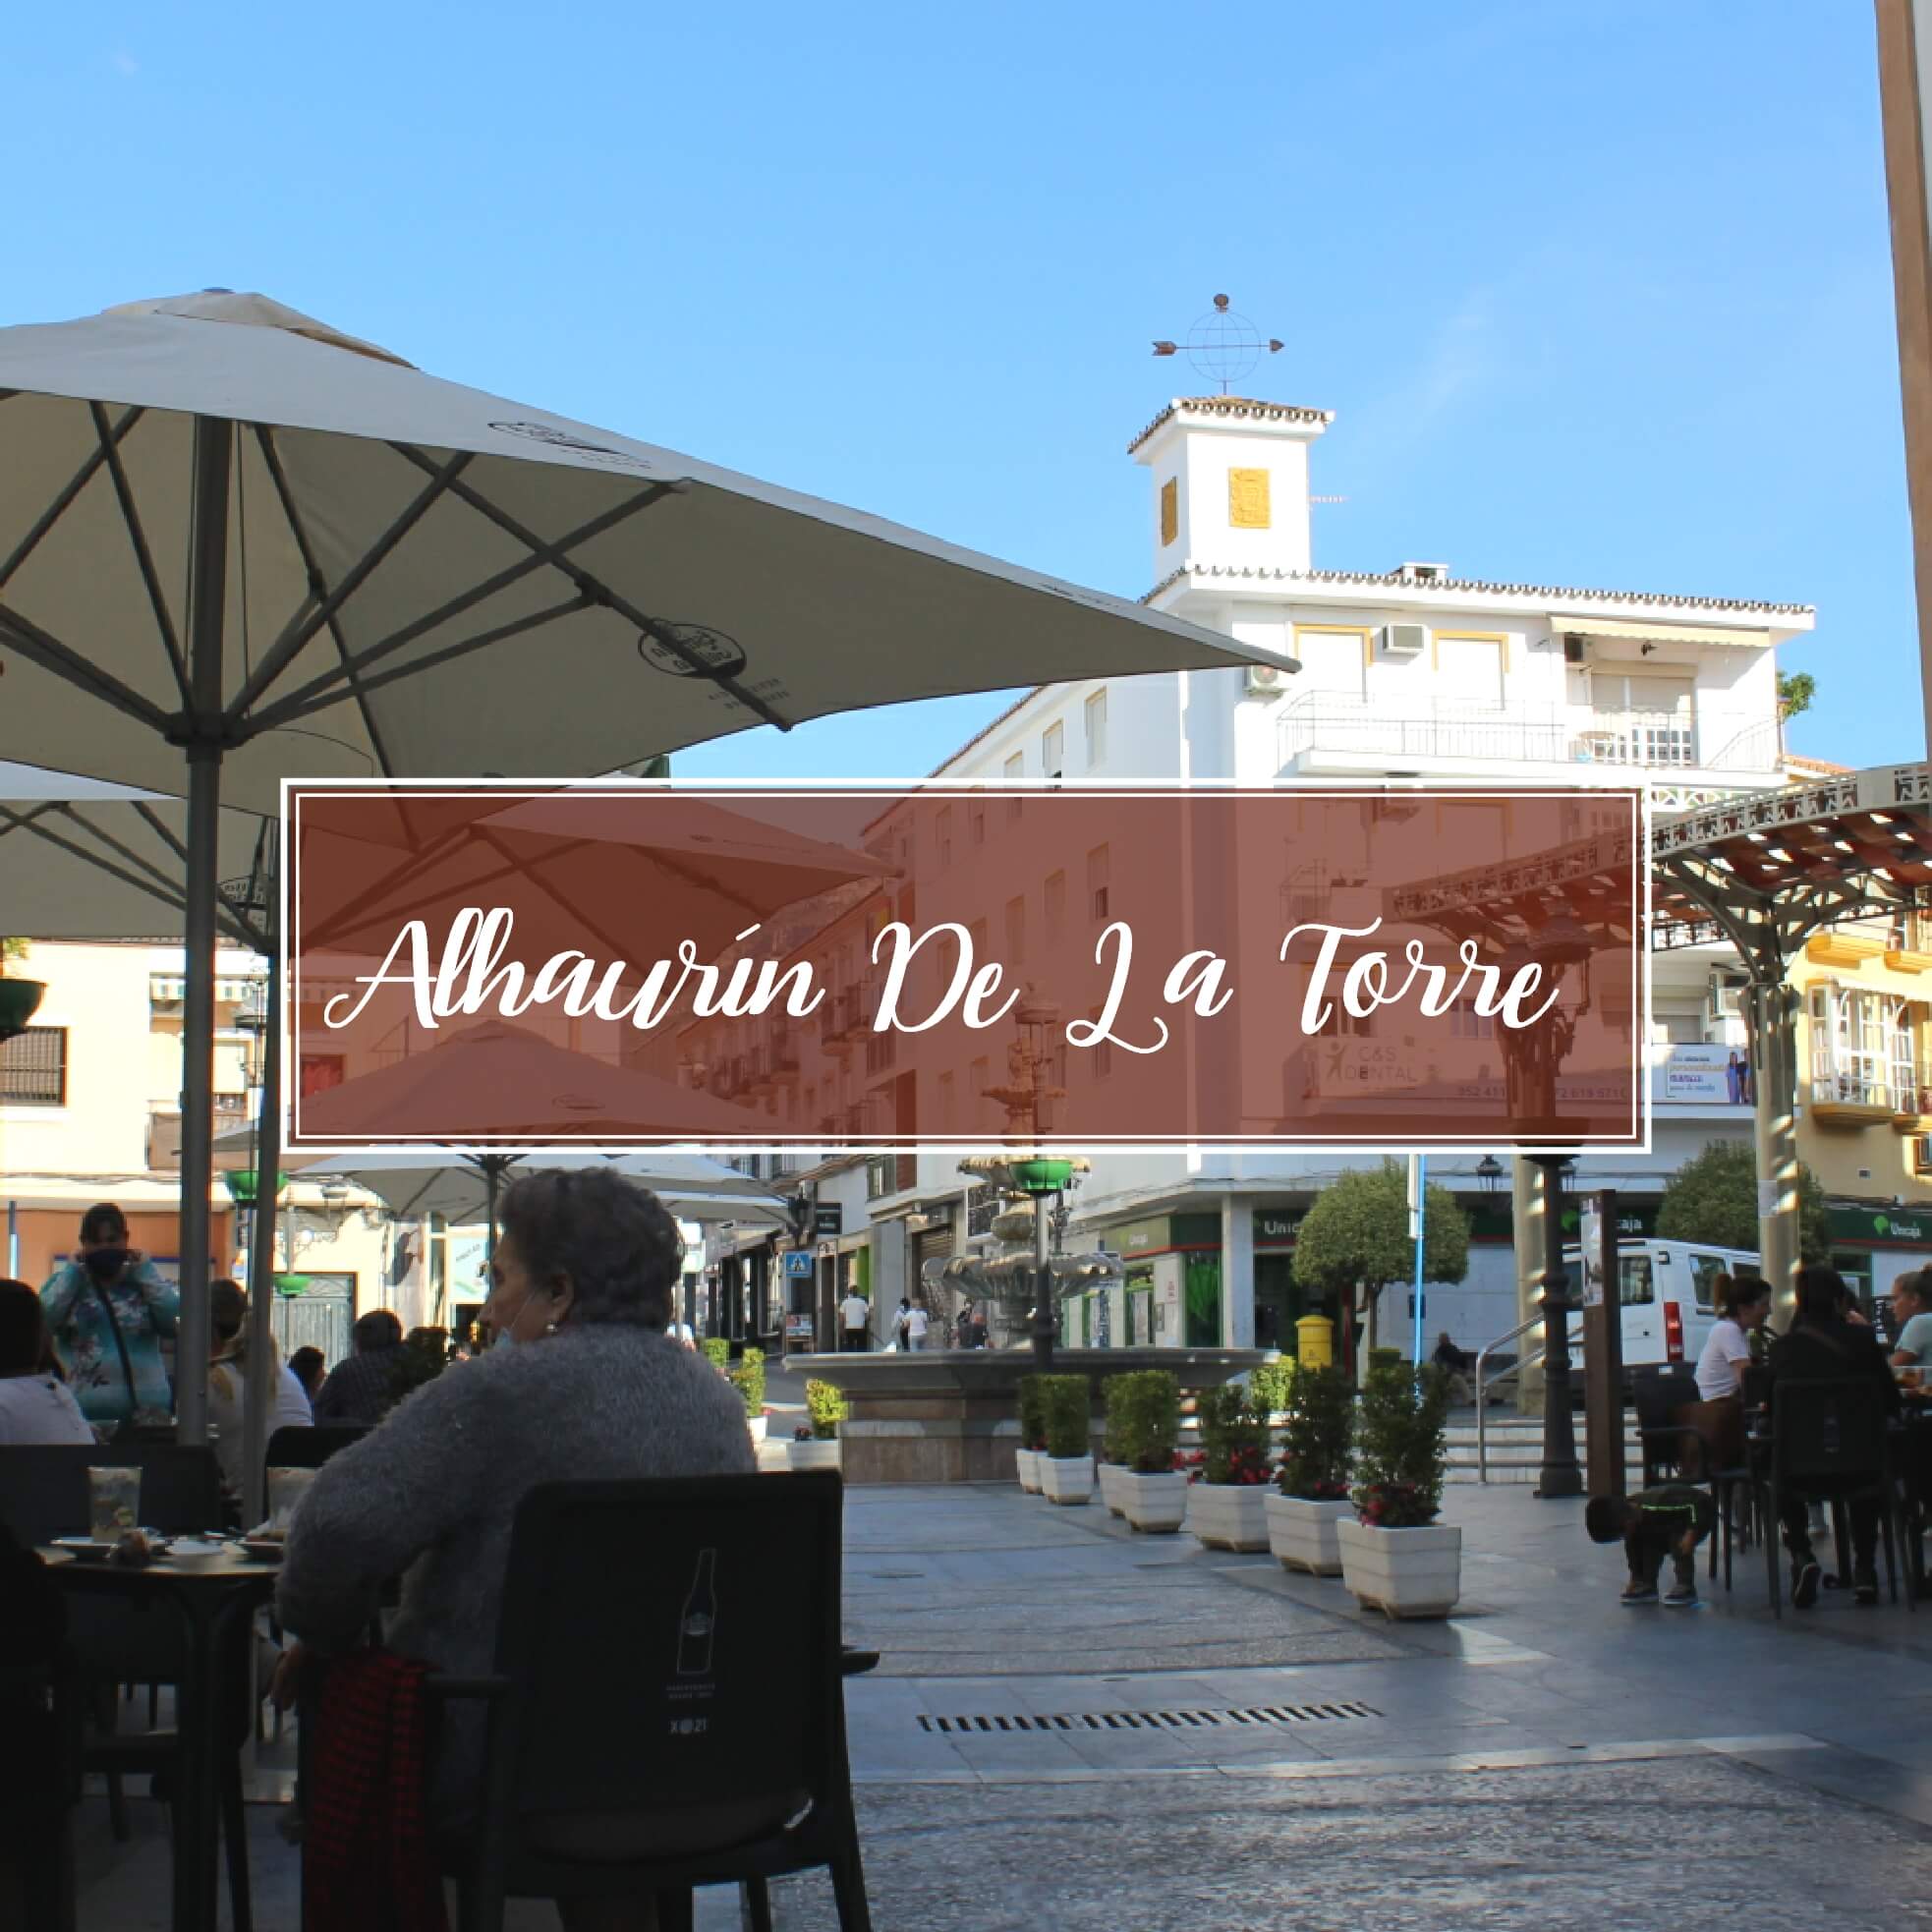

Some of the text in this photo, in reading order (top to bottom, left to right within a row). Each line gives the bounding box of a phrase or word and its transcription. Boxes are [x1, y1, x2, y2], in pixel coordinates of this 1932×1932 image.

[1358, 1046, 1399, 1062] C&S
[1344, 1064, 1418, 1083] DENTAL
[1264, 1220, 1301, 1235] Unic
